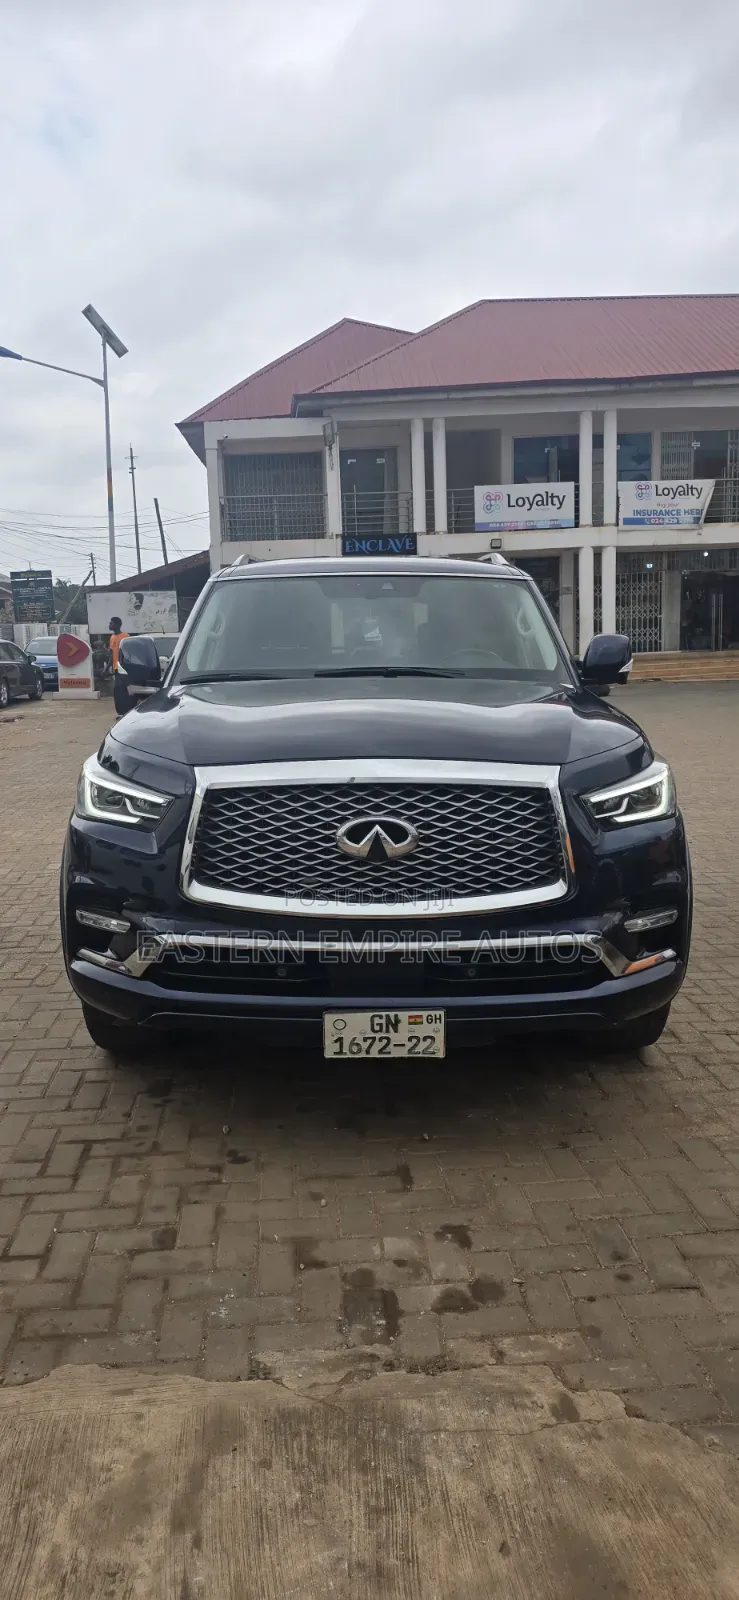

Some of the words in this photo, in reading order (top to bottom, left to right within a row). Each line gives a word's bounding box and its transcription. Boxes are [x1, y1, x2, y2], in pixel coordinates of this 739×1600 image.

[507, 491, 566, 511] Loyalty
[655, 484, 703, 500] Loyalty
[632, 509, 682, 517] INSURANCE
[345, 535, 414, 553] ENCLAVE
[370, 1013, 400, 1034] GN
[426, 1013, 442, 1025] GH
[332, 1035, 437, 1056] 1672-22
